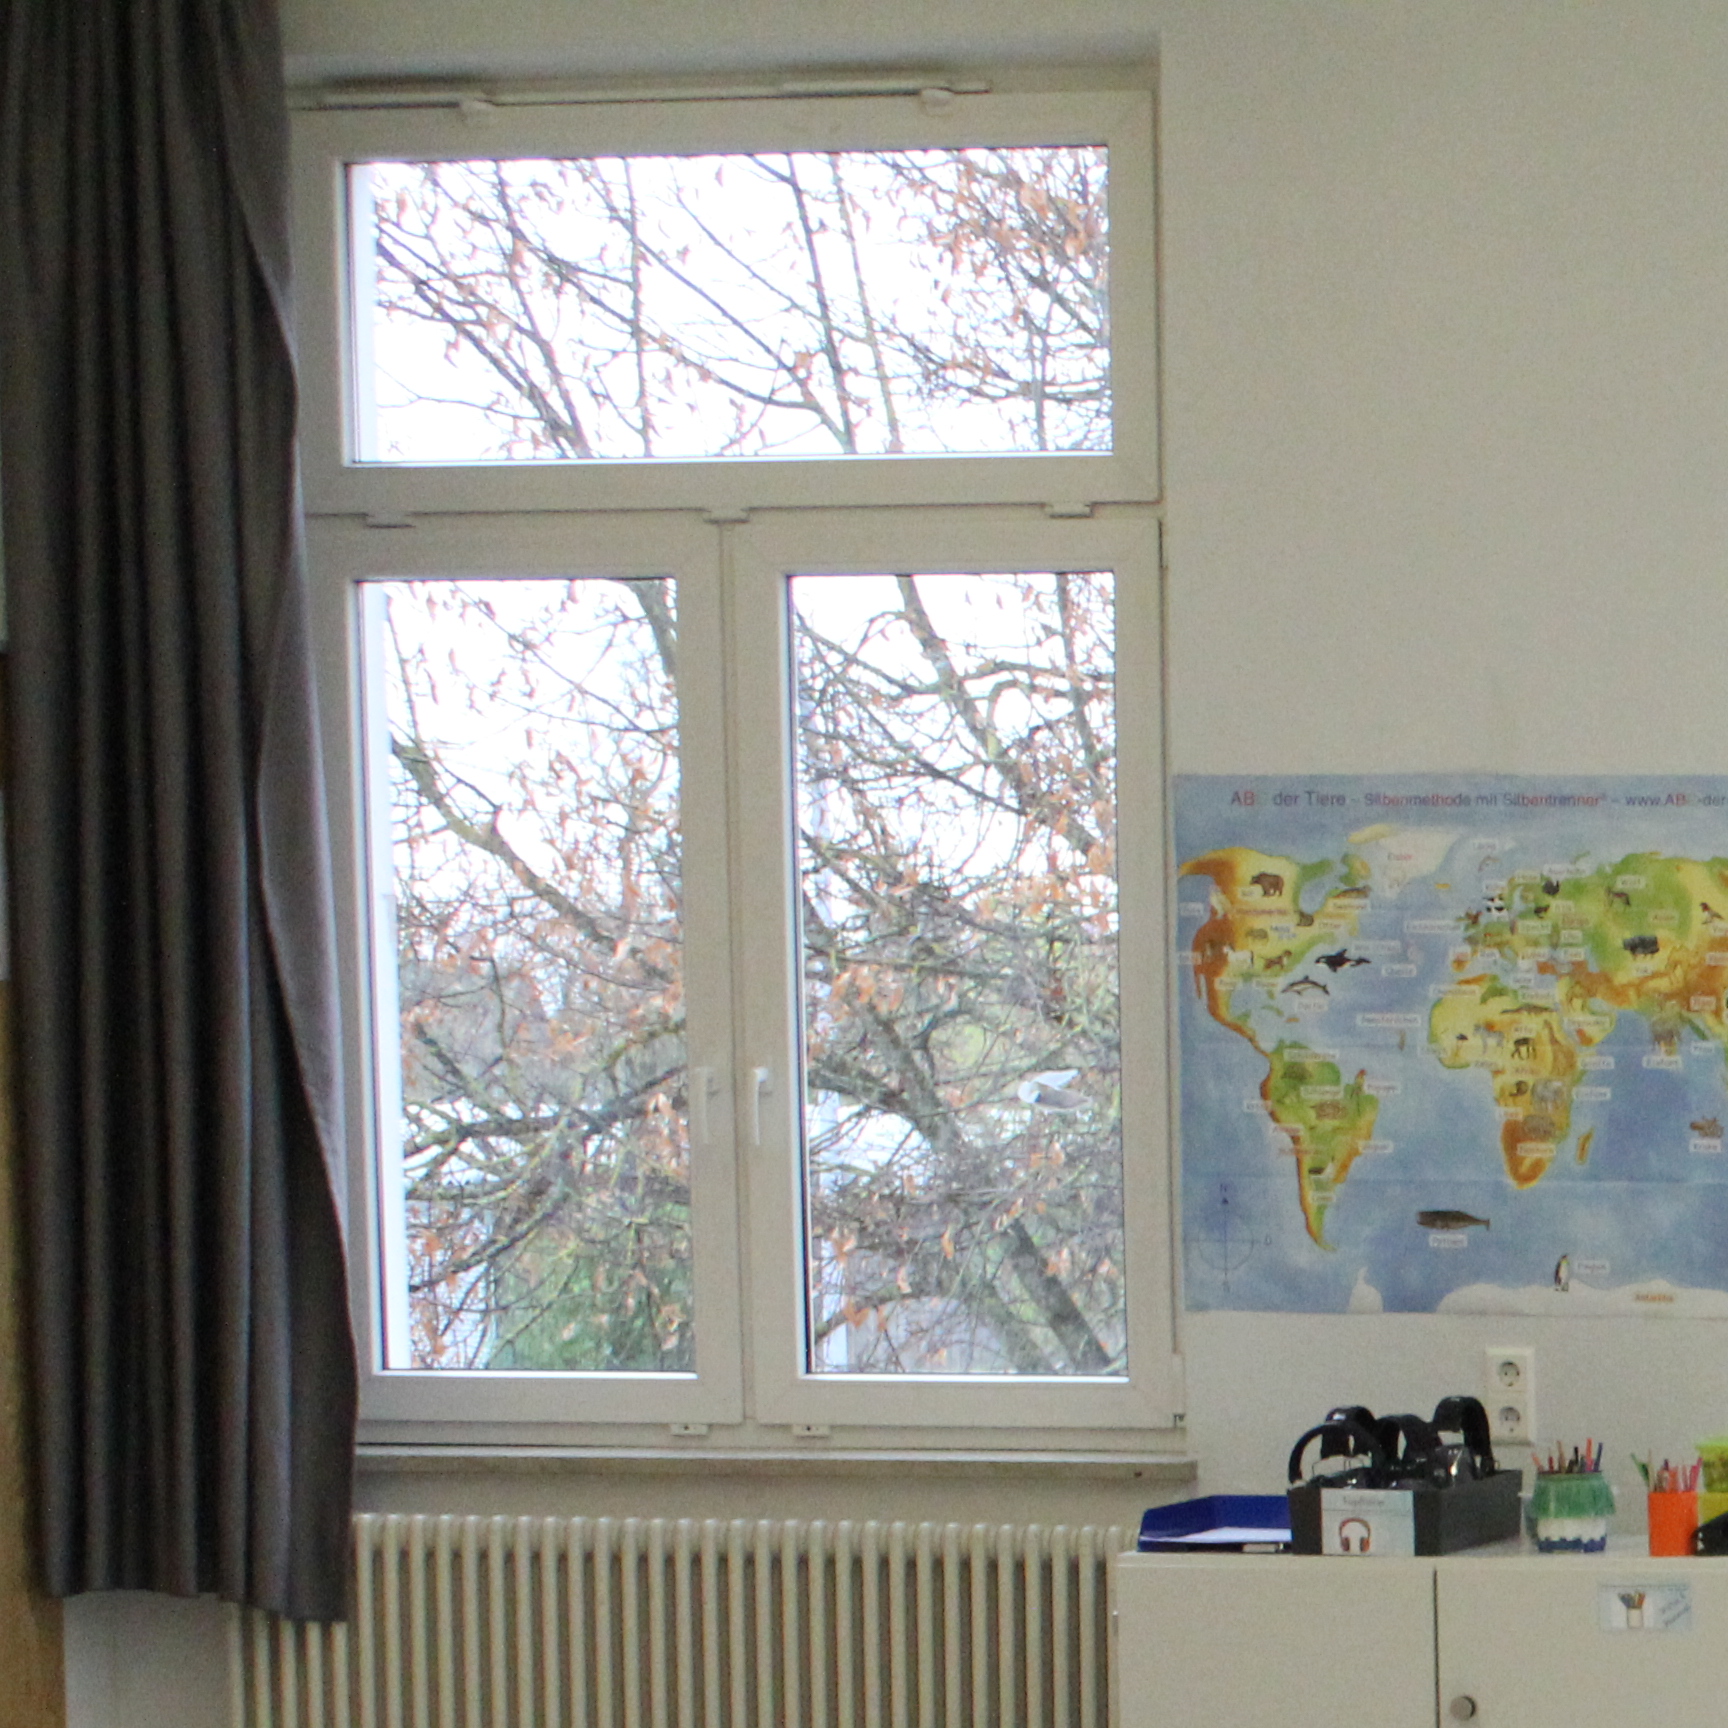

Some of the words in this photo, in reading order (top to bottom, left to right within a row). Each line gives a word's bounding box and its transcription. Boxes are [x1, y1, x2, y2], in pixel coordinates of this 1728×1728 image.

[1230, 790, 1268, 806] AB
[1273, 790, 1300, 807] der
[1304, 789, 1347, 807] Tiere
